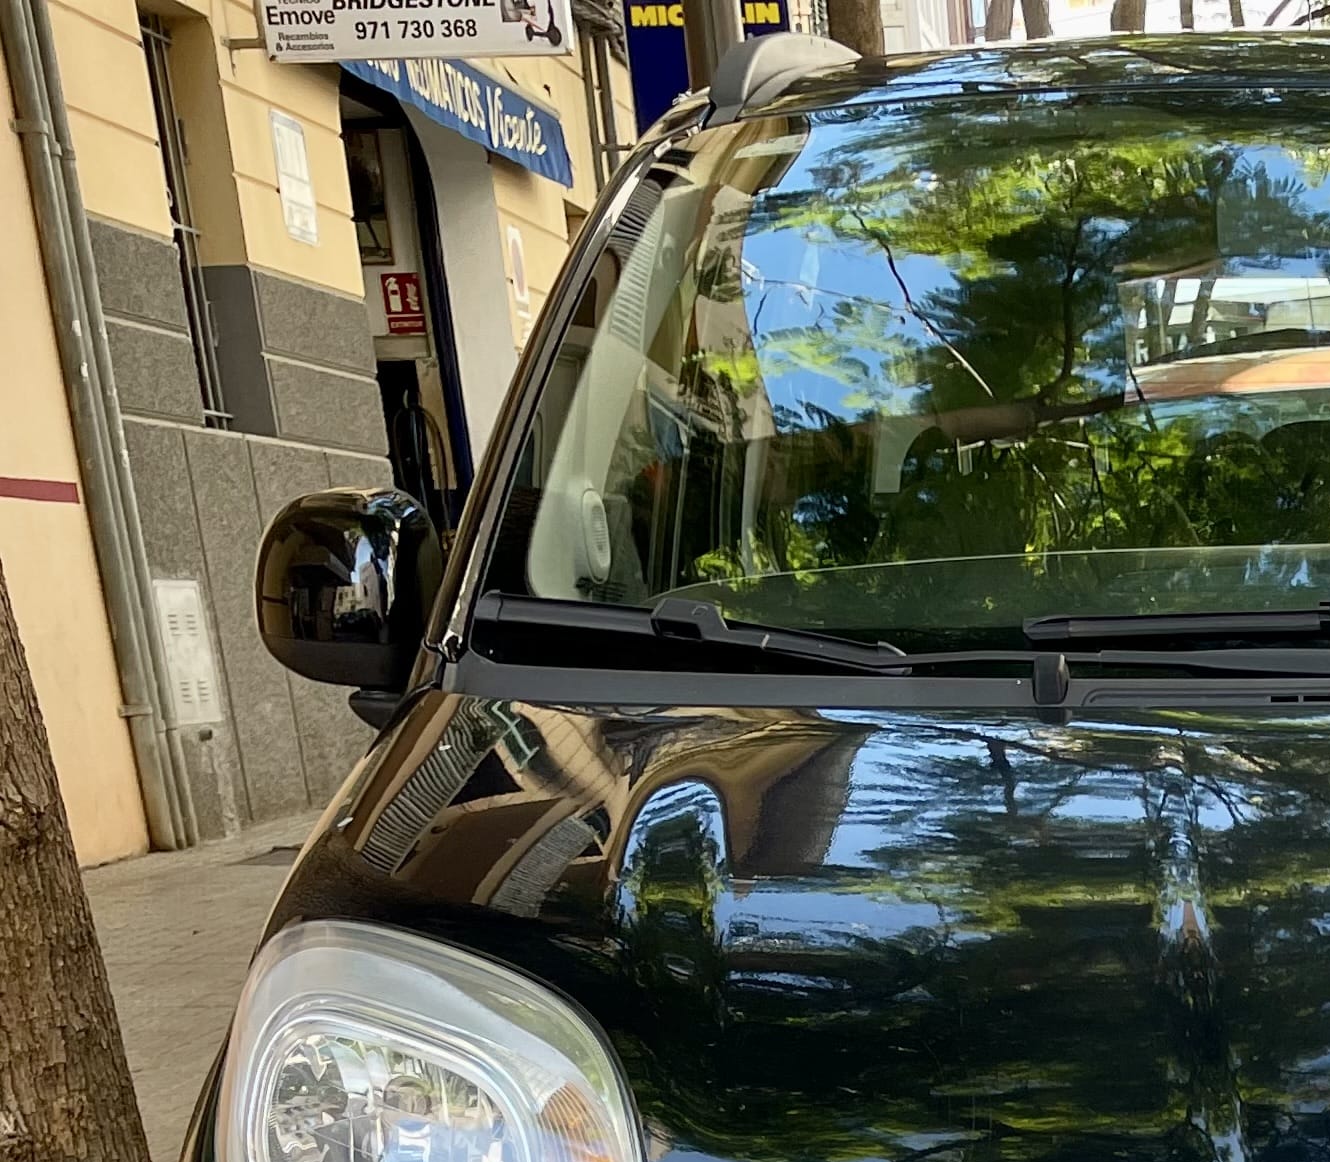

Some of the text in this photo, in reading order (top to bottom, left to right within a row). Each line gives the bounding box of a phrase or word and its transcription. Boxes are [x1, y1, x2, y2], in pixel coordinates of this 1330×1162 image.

[266, 6, 335, 25] Emove
[630, 3, 781, 27] MICIN
[278, 32, 329, 41] Recambios
[355, 18, 478, 40] 971 730 368
[486, 85, 547, 155] Vicente
